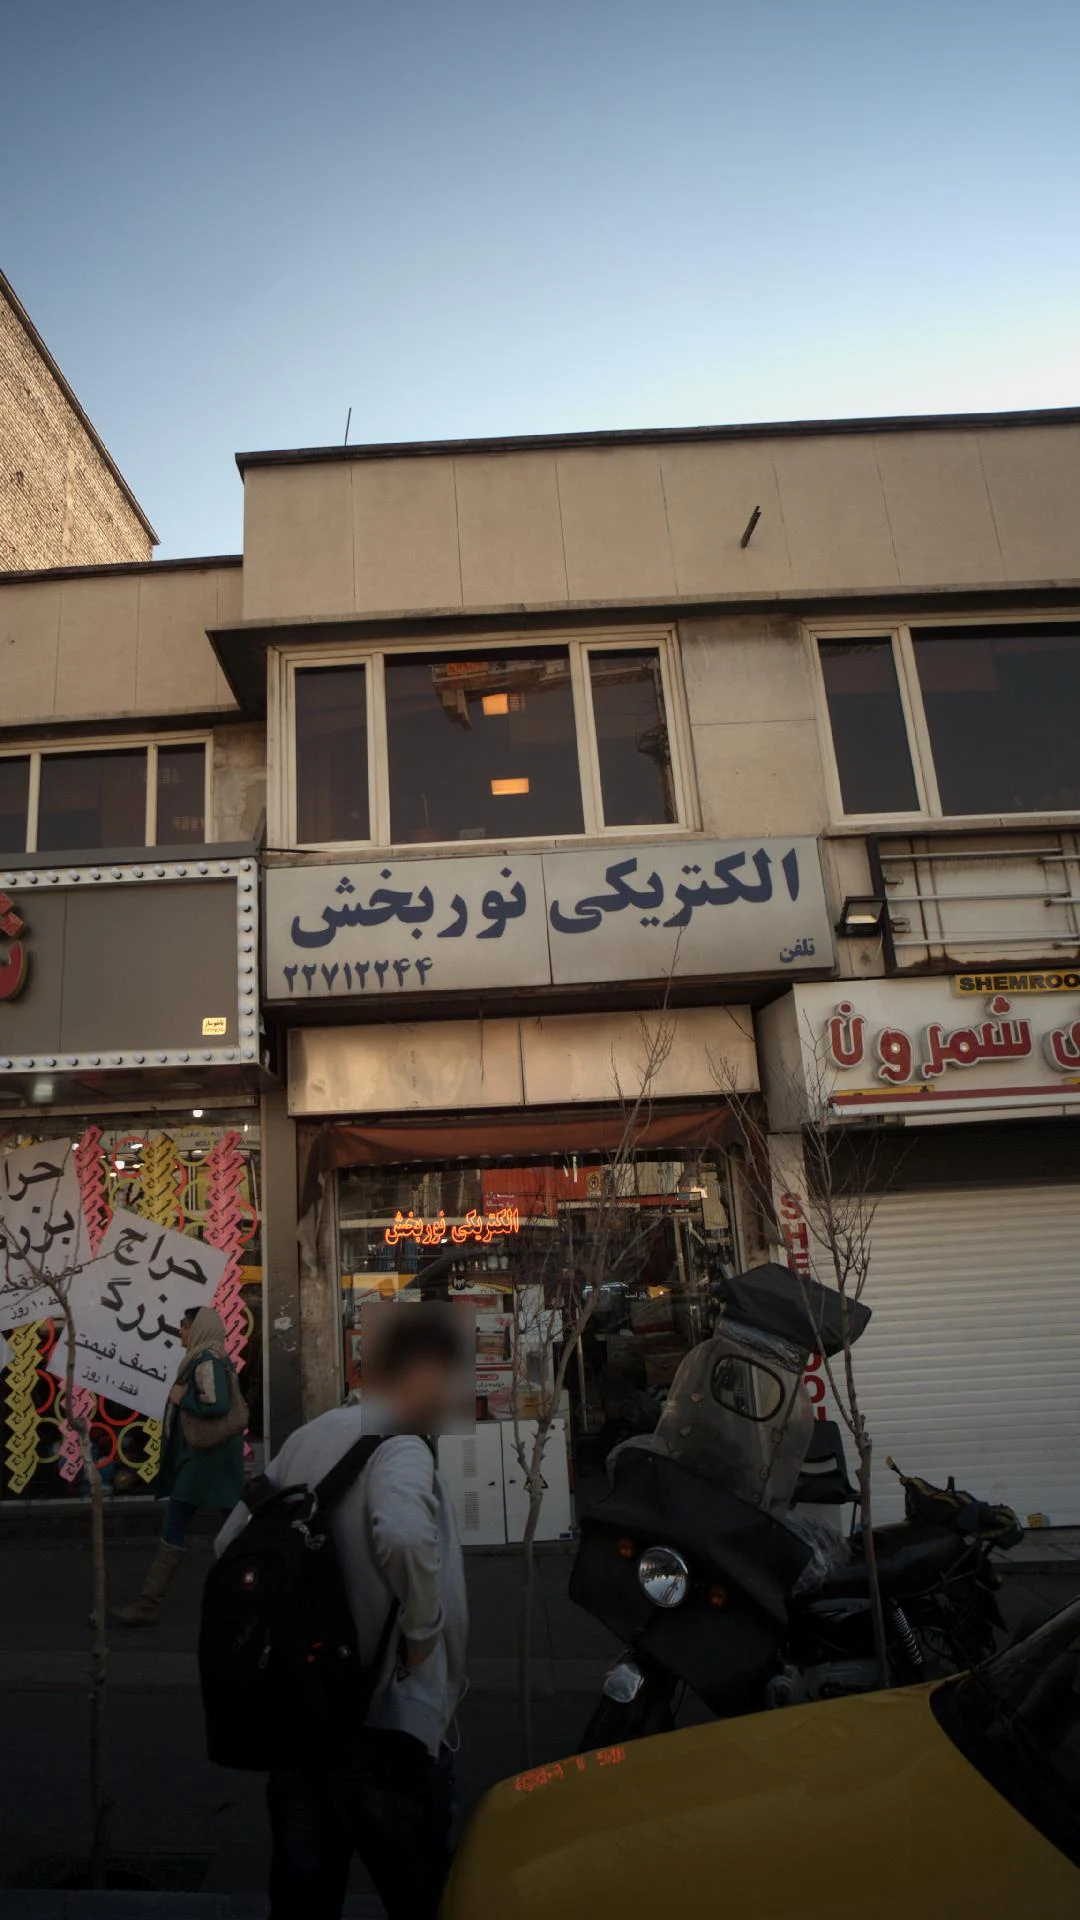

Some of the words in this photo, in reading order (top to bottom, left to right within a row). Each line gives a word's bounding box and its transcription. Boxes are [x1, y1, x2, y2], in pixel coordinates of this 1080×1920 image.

[550, 847, 800, 934] الکتریکی
[779, 936, 816, 963] تلفن
[283, 956, 434, 993] ۲۲۷۱۲۲۴۴
[829, 994, 1033, 1084] شمرون
[0, 1159, 64, 1201] حرا
[0, 1206, 75, 1259] بزر
[451, 1207, 519, 1242] الکتریکی
[114, 1227, 208, 1285] حراج
[82, 1367, 100, 1382] روز
[119, 1352, 168, 1382] نصف
